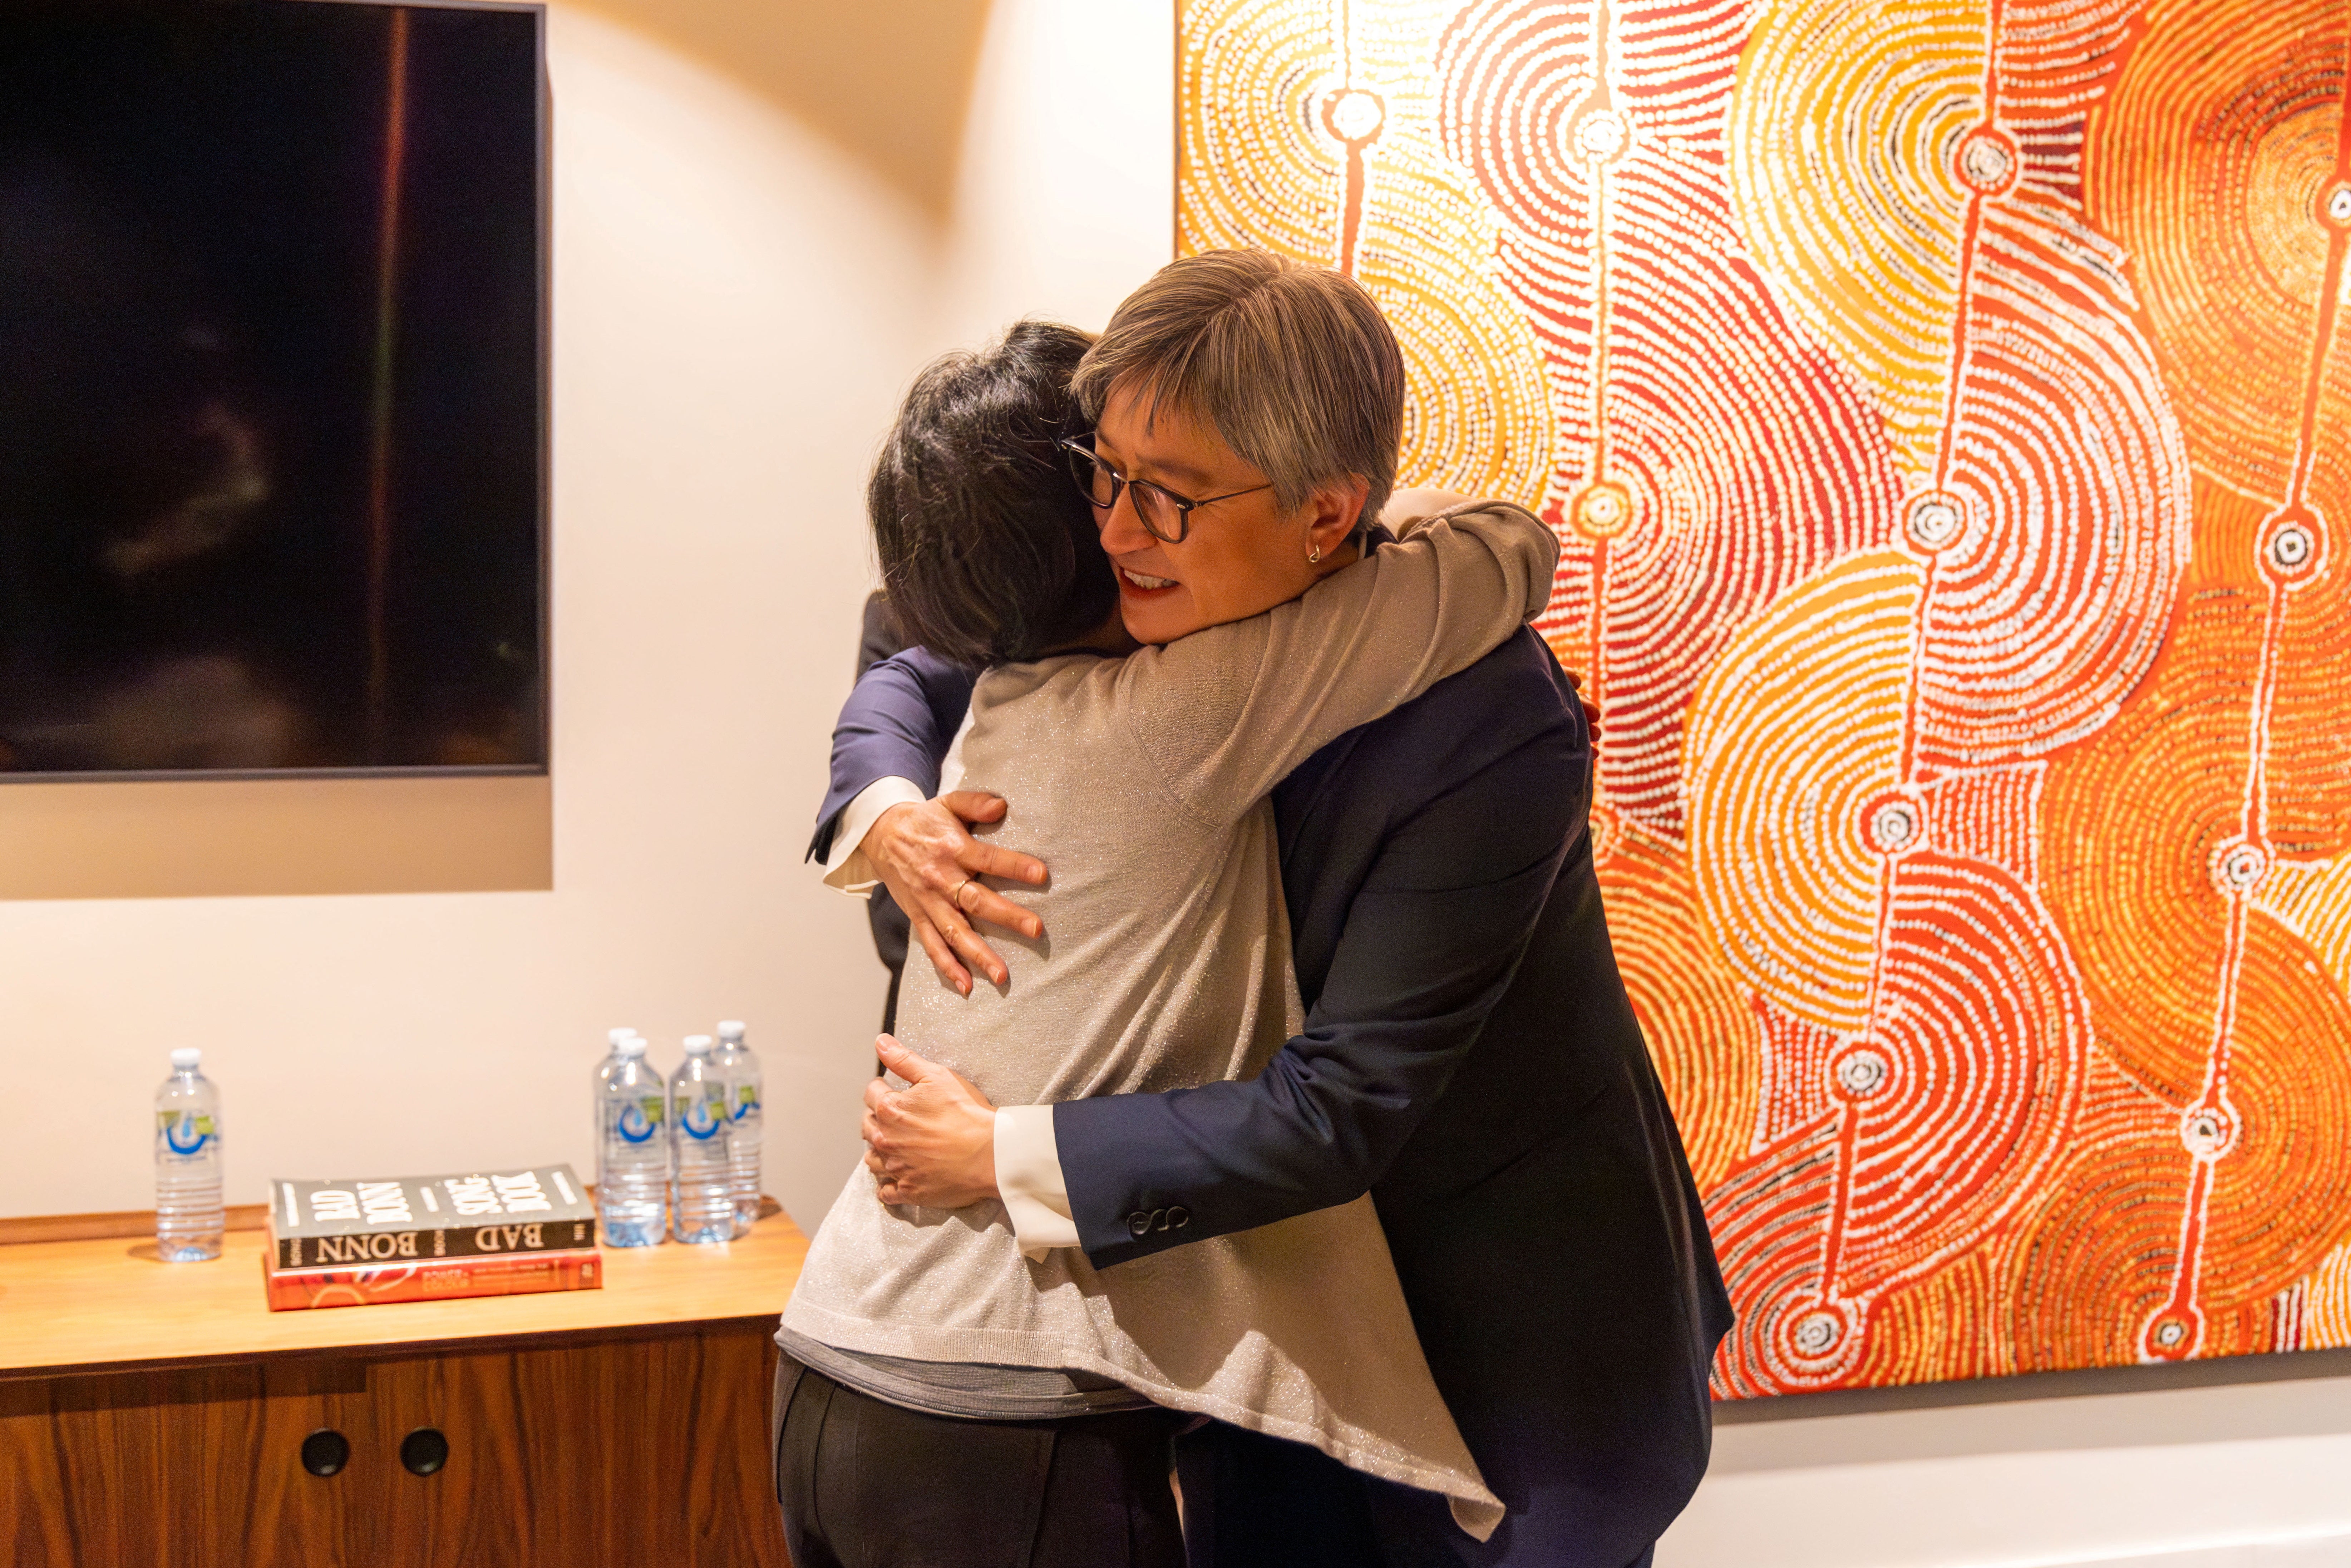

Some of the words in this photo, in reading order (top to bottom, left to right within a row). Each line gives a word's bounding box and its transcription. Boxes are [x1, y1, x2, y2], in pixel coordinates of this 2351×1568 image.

[310, 1190, 361, 1222] BAD
[356, 1182, 413, 1224] BONN
[444, 1177, 503, 1215] SONG
[491, 1171, 552, 1213] BOOK
[316, 1232, 418, 1263] BONN
[475, 1223, 544, 1251] BAD
